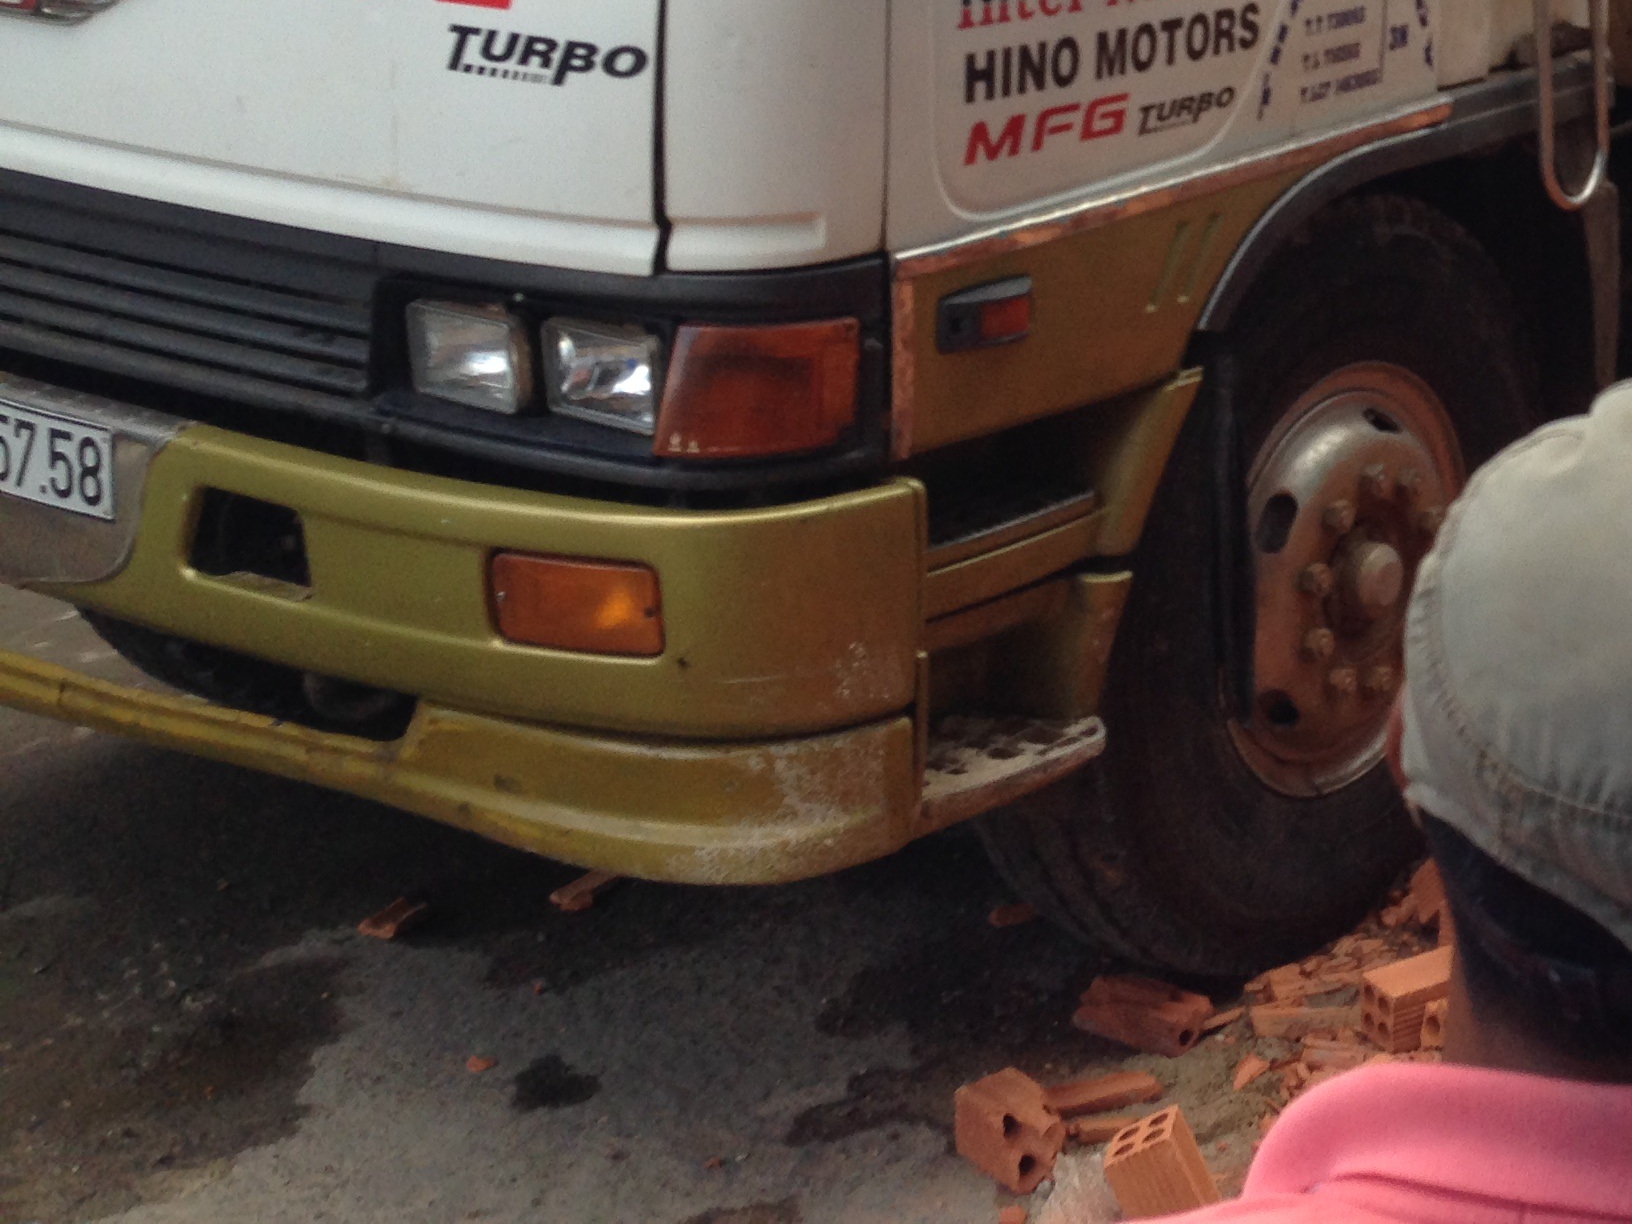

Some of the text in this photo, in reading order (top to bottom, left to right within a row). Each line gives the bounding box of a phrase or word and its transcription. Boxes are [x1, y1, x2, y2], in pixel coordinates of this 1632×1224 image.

[446, 23, 649, 87] TURBO
[963, 35, 1081, 105] HINO
[1095, 1, 1261, 80] MOTORS
[963, 86, 1237, 165] MFG TURBO
